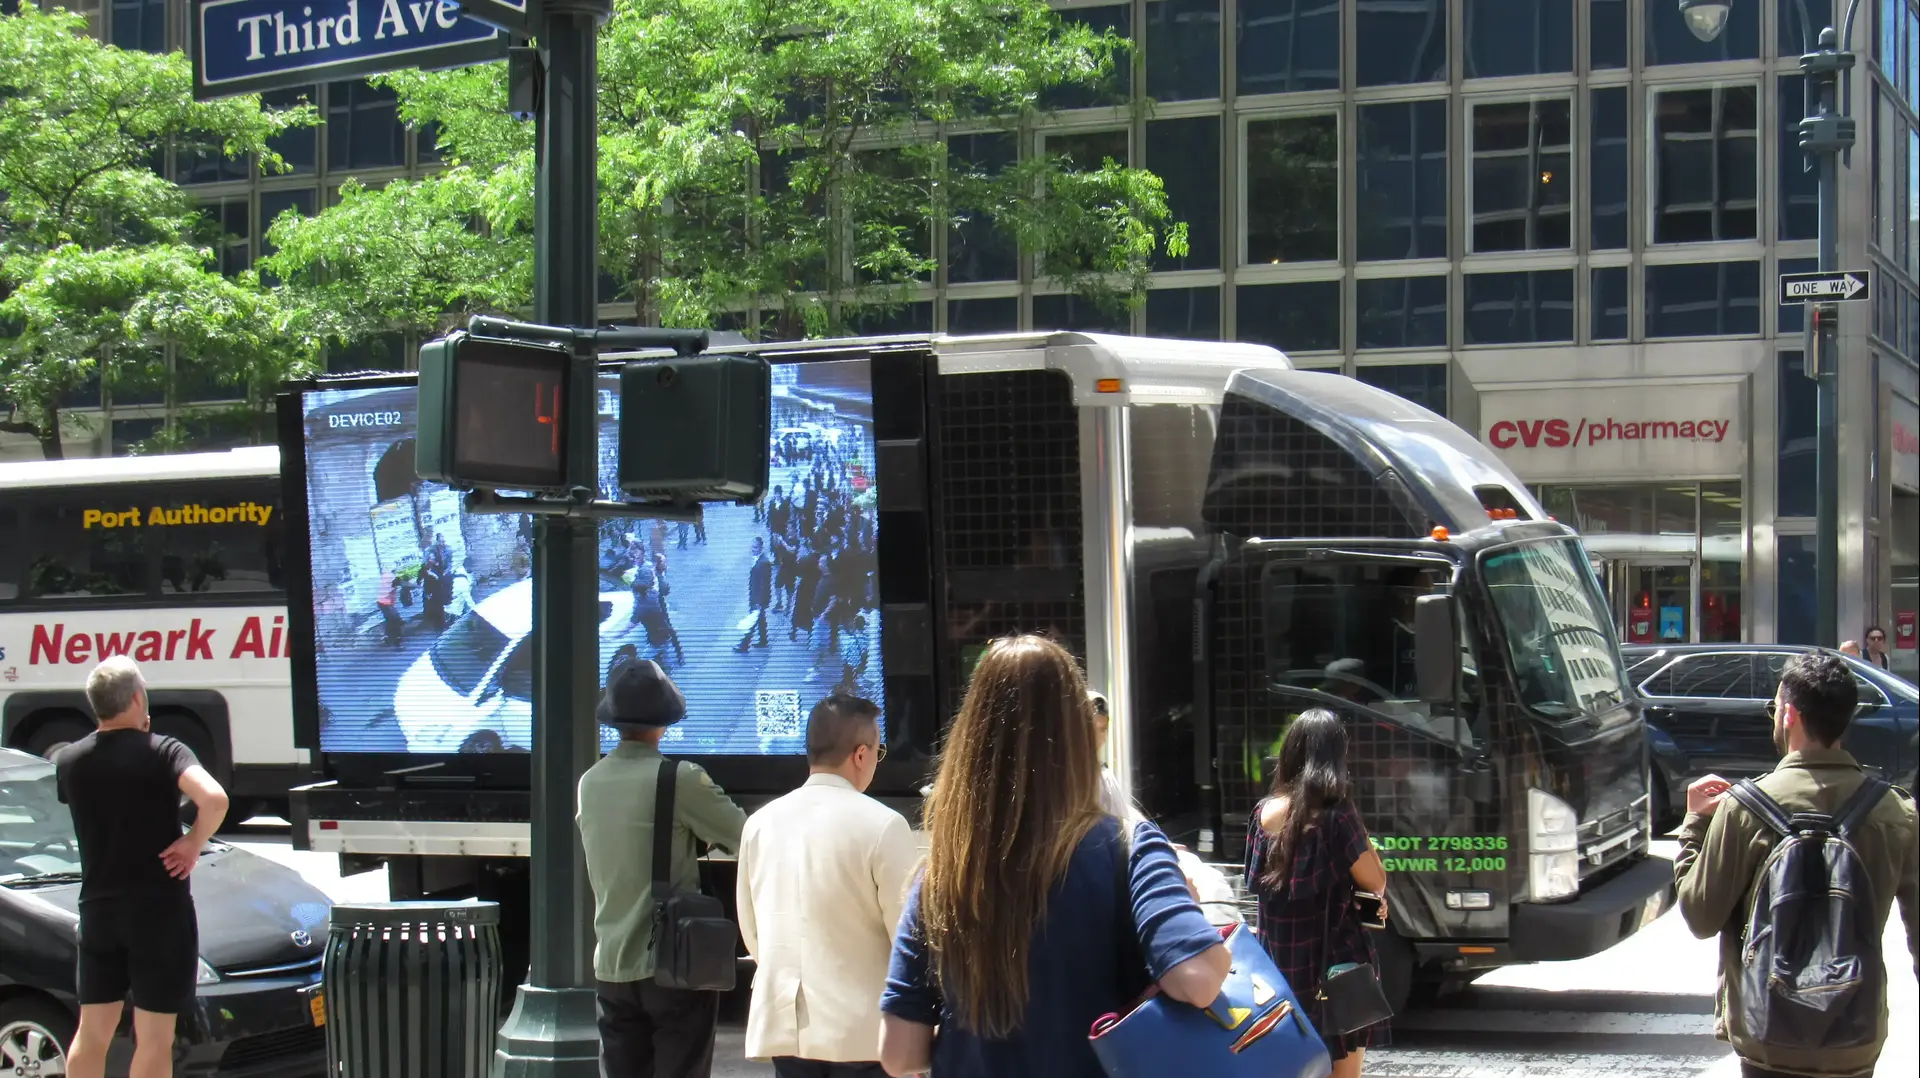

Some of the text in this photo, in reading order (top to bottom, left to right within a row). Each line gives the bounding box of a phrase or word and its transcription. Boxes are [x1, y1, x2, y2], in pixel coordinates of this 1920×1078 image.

[238, 0, 459, 61] Third Ave
[1793, 280, 1856, 294] ONE WAY
[328, 411, 402, 428] DEVICE02
[83, 502, 273, 529] Port Authority
[29, 618, 216, 665] Newark
[1428, 836, 1508, 851] 2798336
[1382, 857, 1506, 873] GVWR 12,000
